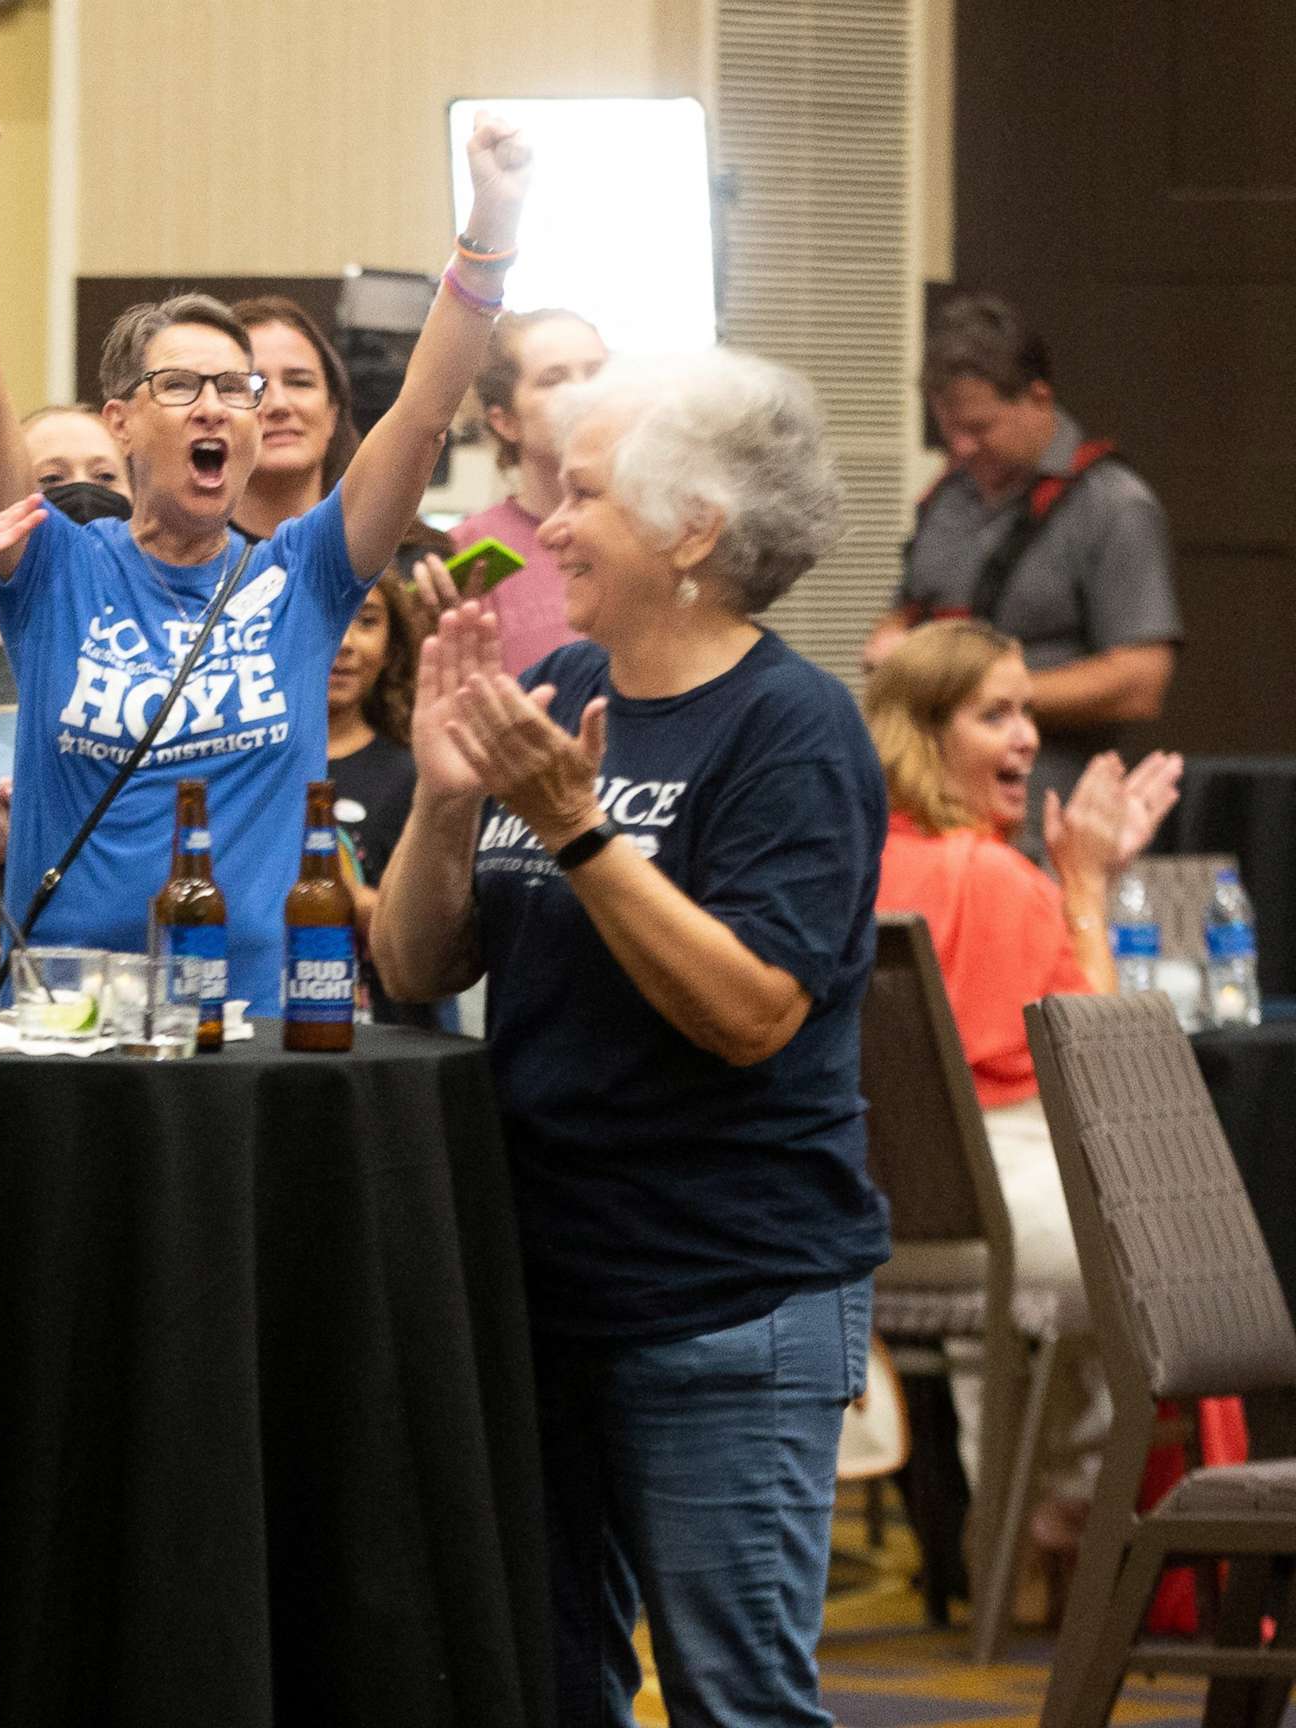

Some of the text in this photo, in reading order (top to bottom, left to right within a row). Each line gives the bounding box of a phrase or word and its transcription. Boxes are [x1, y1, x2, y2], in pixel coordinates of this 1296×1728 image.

[59, 653, 286, 746] HOYE
[156, 728, 267, 765] DISTRICT
[296, 961, 347, 980] BUD
[288, 979, 353, 999] LIGHT
